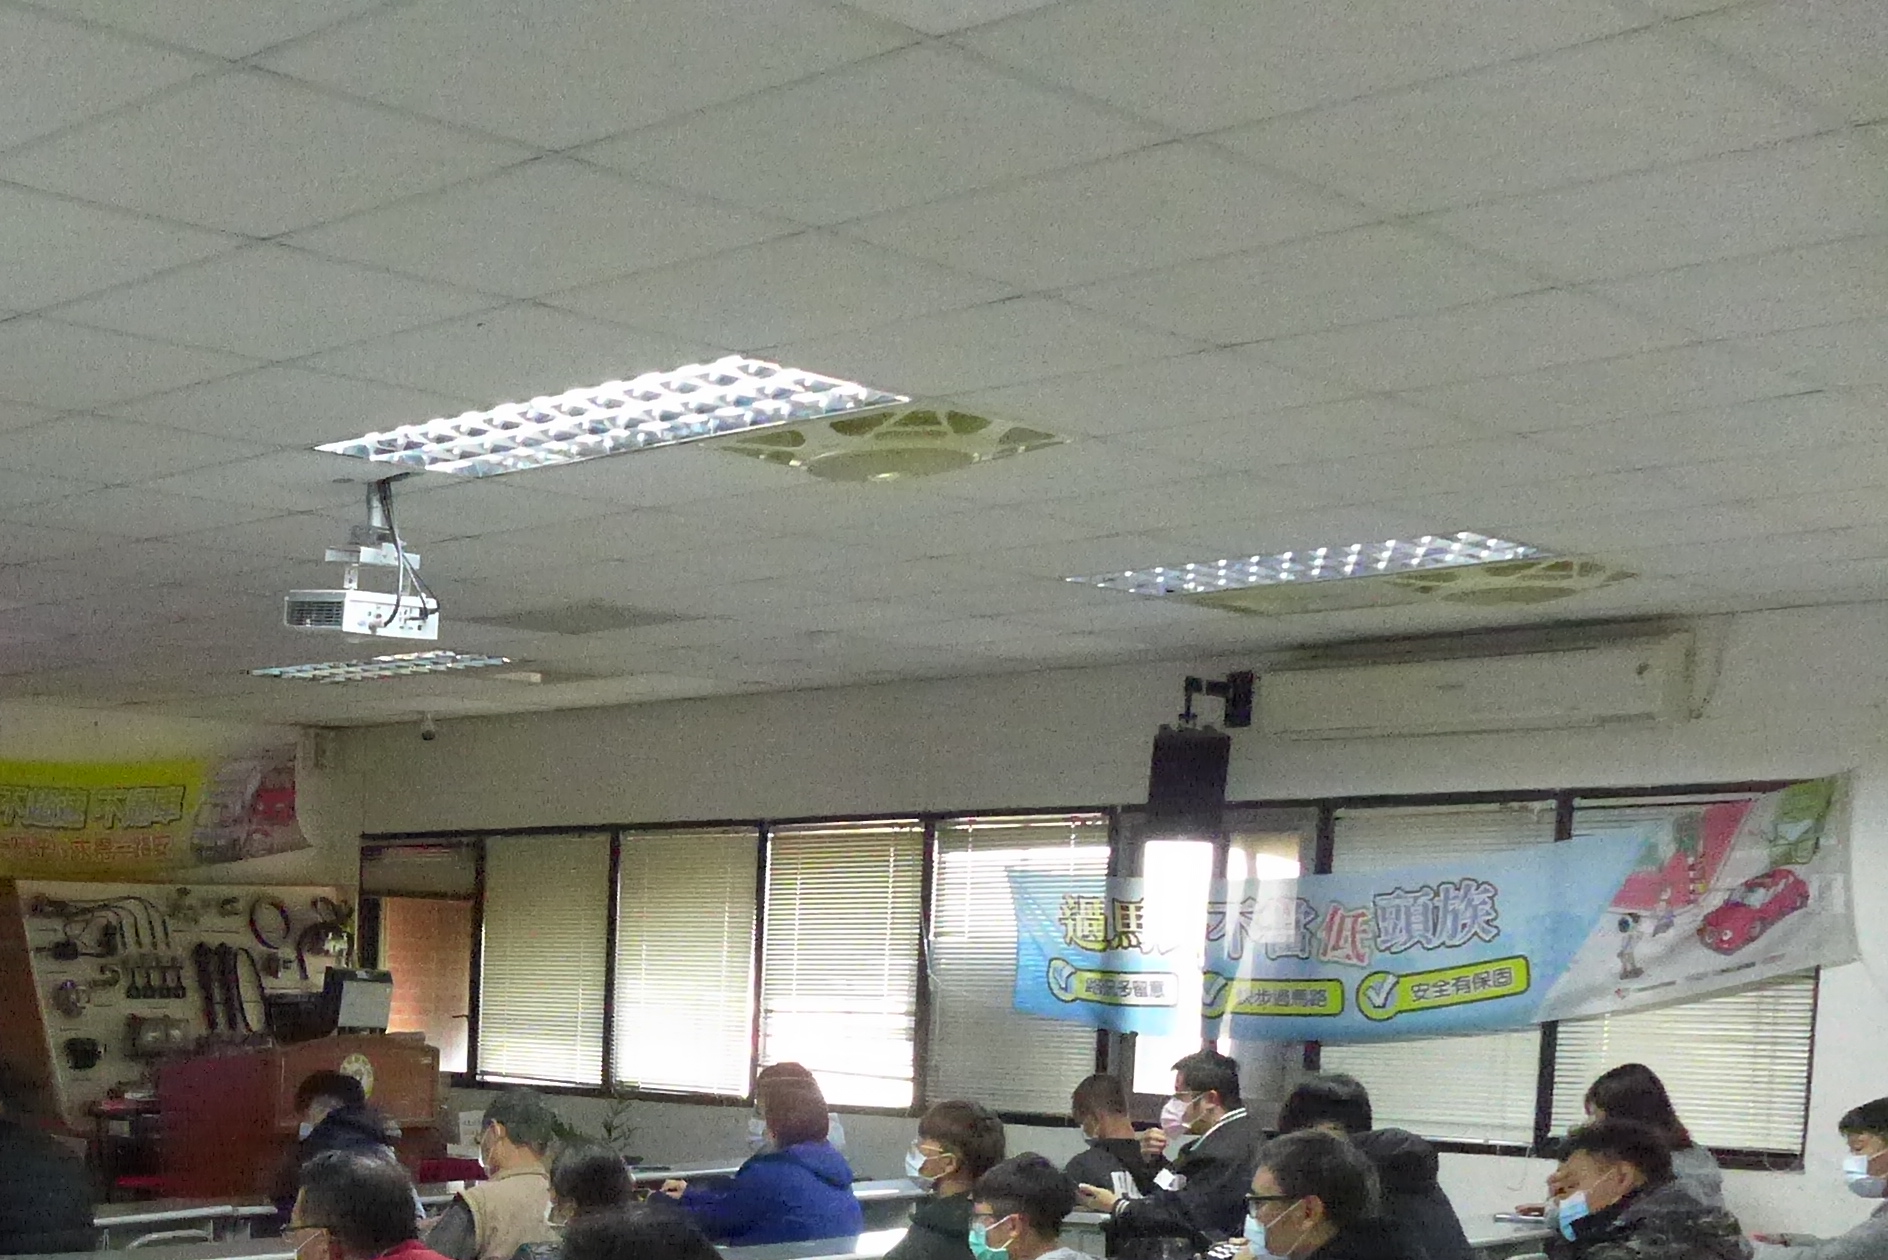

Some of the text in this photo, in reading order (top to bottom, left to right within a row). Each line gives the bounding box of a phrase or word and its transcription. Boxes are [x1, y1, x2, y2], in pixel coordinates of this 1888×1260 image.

[1058, 878, 1501, 967] 過馬不當低頭族
[1410, 967, 1513, 1002] 安全有保固
